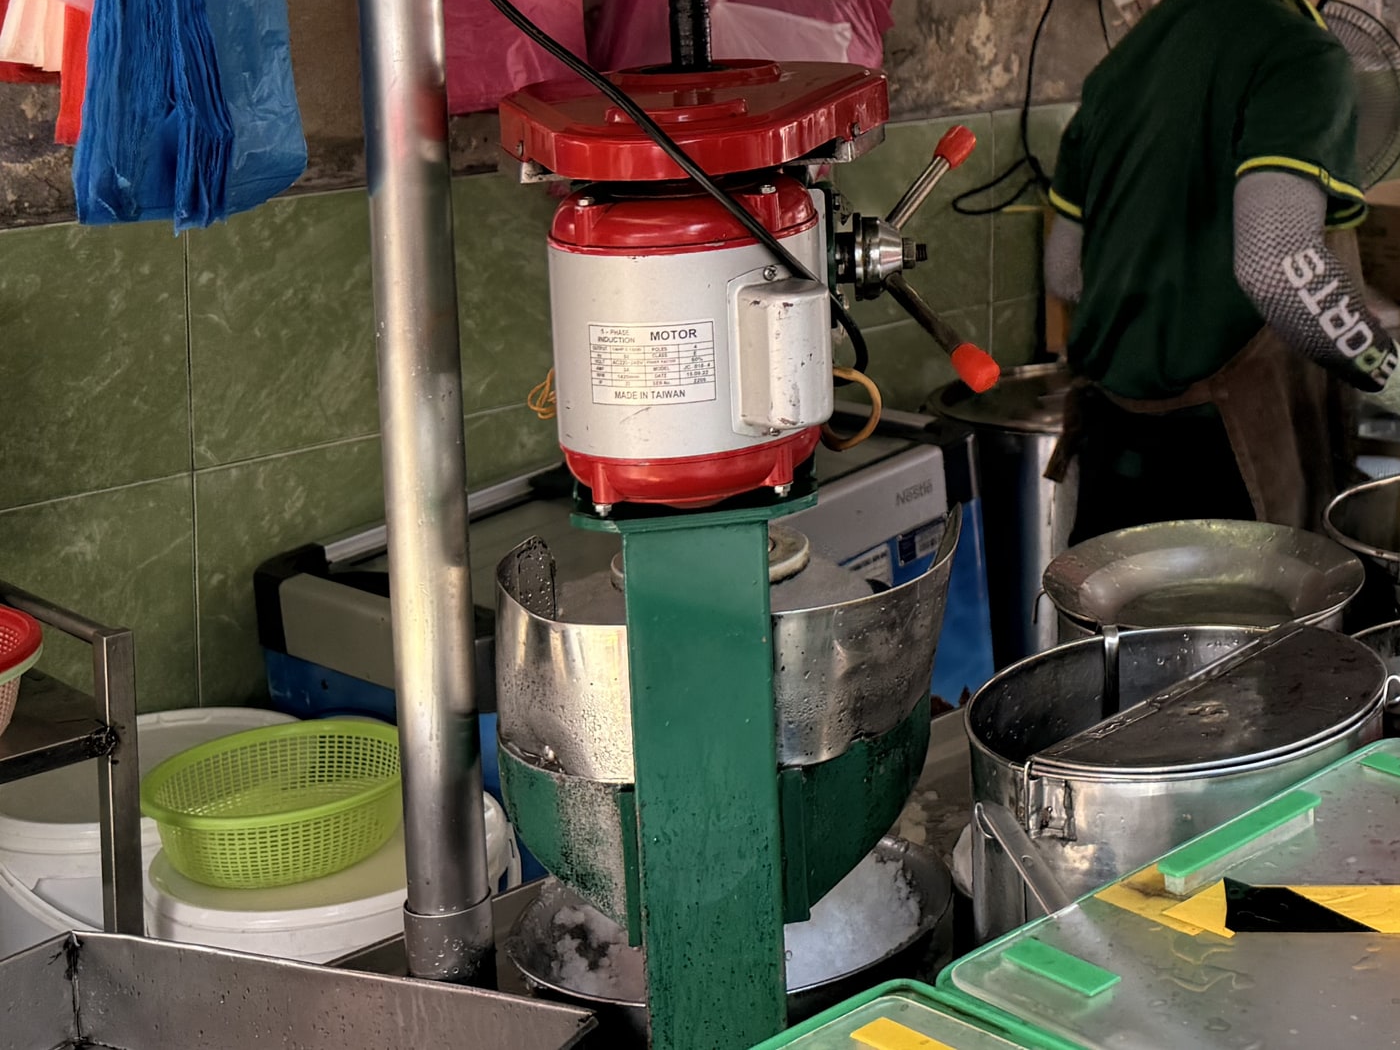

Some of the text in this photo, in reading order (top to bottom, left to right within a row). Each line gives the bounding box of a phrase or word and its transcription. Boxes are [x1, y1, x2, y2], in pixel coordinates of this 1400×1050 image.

[650, 329, 697, 341] MOTOR
[614, 389, 686, 399] MADE IN TAIWAN
